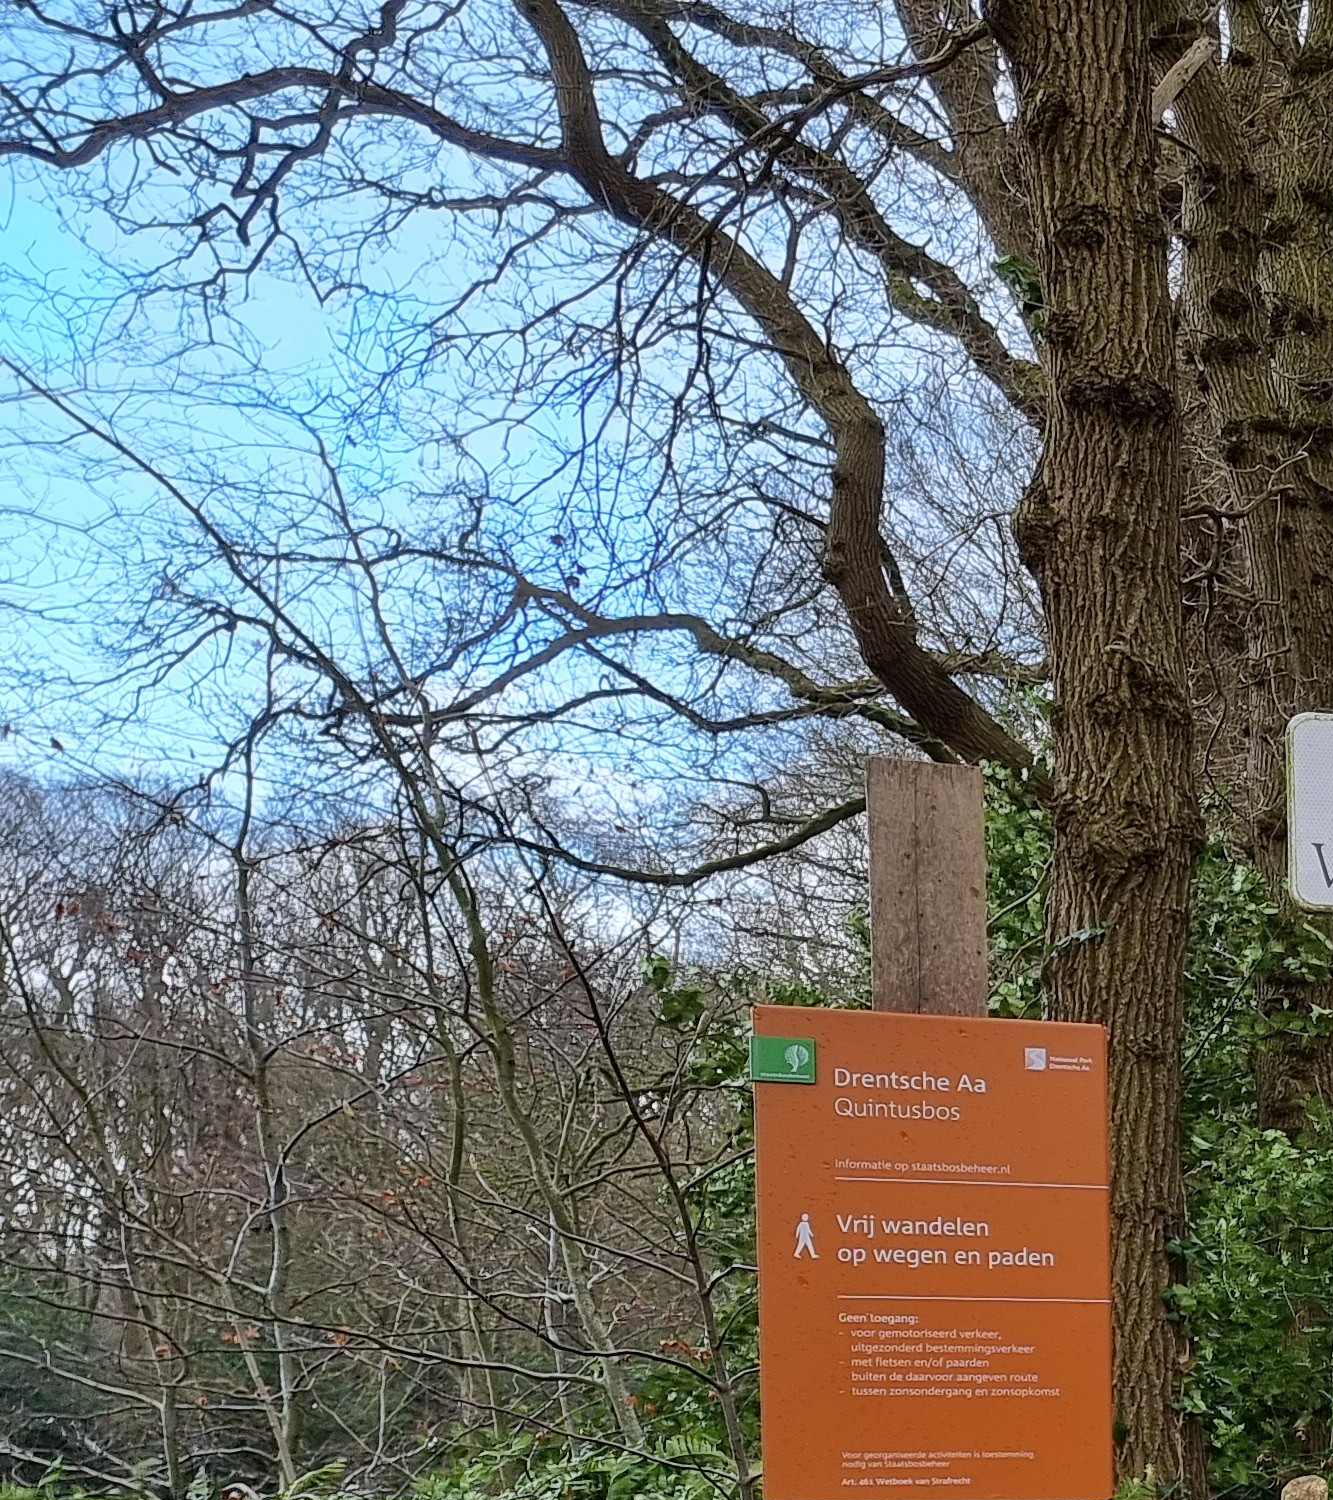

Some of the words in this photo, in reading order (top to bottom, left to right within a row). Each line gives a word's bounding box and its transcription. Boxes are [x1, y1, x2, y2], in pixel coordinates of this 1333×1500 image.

[834, 1067, 950, 1091] Drentsche
[957, 1074, 987, 1093] Aa
[834, 1097, 961, 1121] Quintusbos
[894, 1163, 908, 1173] op
[911, 1162, 1011, 1175] staatsbosbeheer.nl
[836, 1214, 875, 1238] Vrij
[881, 1216, 989, 1237] wandelen
[837, 1248, 866, 1267] op
[873, 1248, 947, 1269] wegen
[954, 1250, 981, 1266] en
[988, 1247, 1055, 1269] paden
[838, 1312, 867, 1324] Geen
[869, 1313, 920, 1326] toegang:
[850, 1329, 875, 1338] voor
[878, 1329, 957, 1341] gemotoriseerd
[959, 1329, 1003, 1341] verkeer,
[850, 1343, 924, 1355] uitgezonderd
[925, 1343, 1036, 1356] bestemmingsverkeer
[851, 1358, 873, 1367] met
[875, 1357, 912, 1367] fietsen
[914, 1357, 944, 1368] en/of
[945, 1357, 990, 1369] paarden
[851, 1371, 886, 1382] buiten
[889, 1372, 903, 1382] de
[905, 1372, 954, 1382] daarvoor
[956, 1374, 1008, 1385] aangeven
[1009, 1373, 1039, 1383] route
[851, 1387, 887, 1396] tussen
[889, 1387, 972, 1398] zonsondergang
[974, 1388, 988, 1396] en
[990, 1387, 1060, 1398] zonsopkomst
[875, 1477, 914, 1486] Wetboek
[914, 1478, 930, 1486] van
[931, 1477, 971, 1486] Strafrecht
